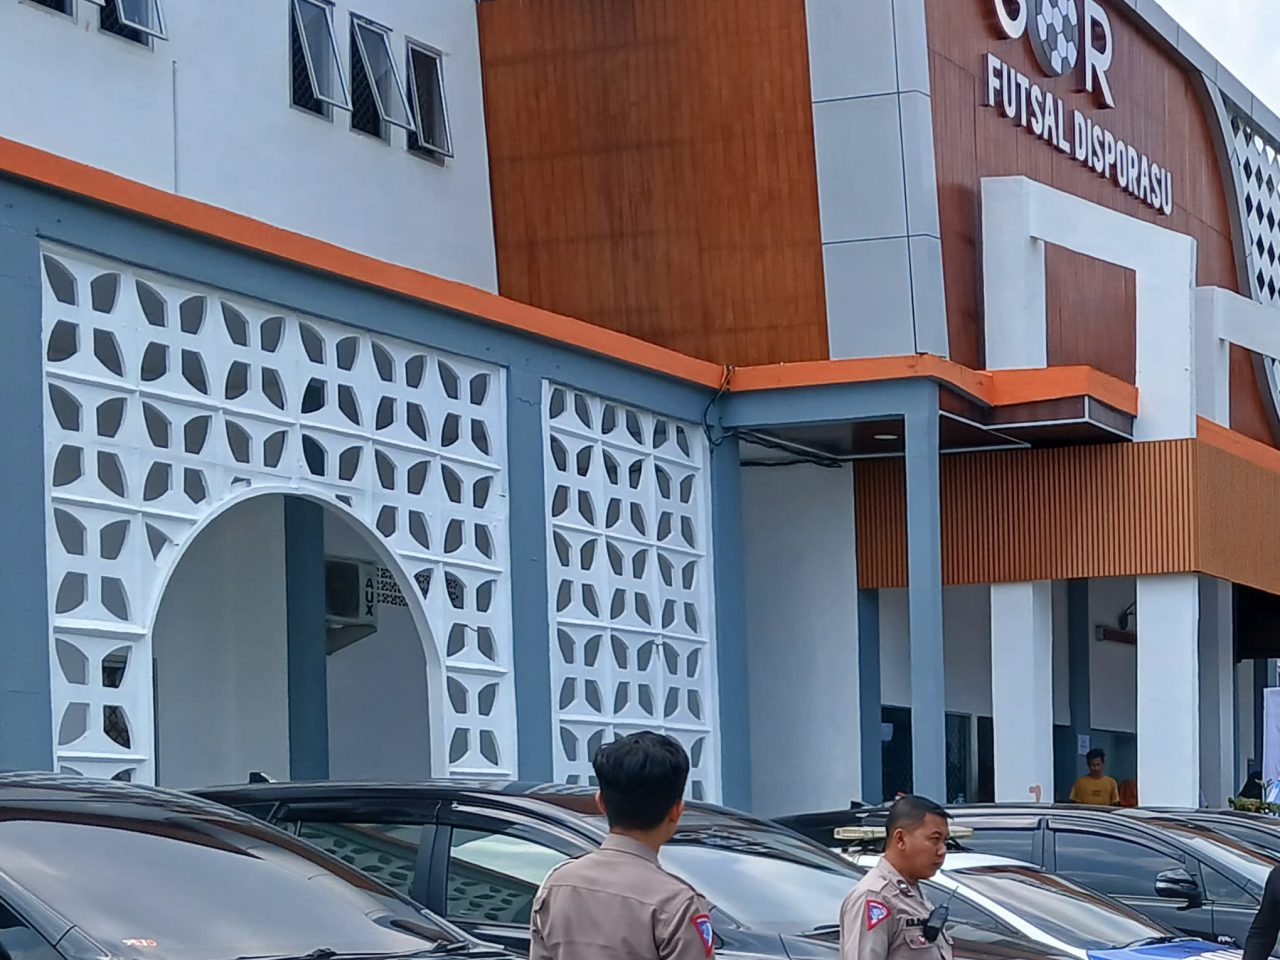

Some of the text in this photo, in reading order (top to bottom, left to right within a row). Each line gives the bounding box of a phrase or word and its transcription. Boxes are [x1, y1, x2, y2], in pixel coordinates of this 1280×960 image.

[985, 52, 1173, 216] FUTSAL DISPORASU
[364, 577, 374, 616] AUX
